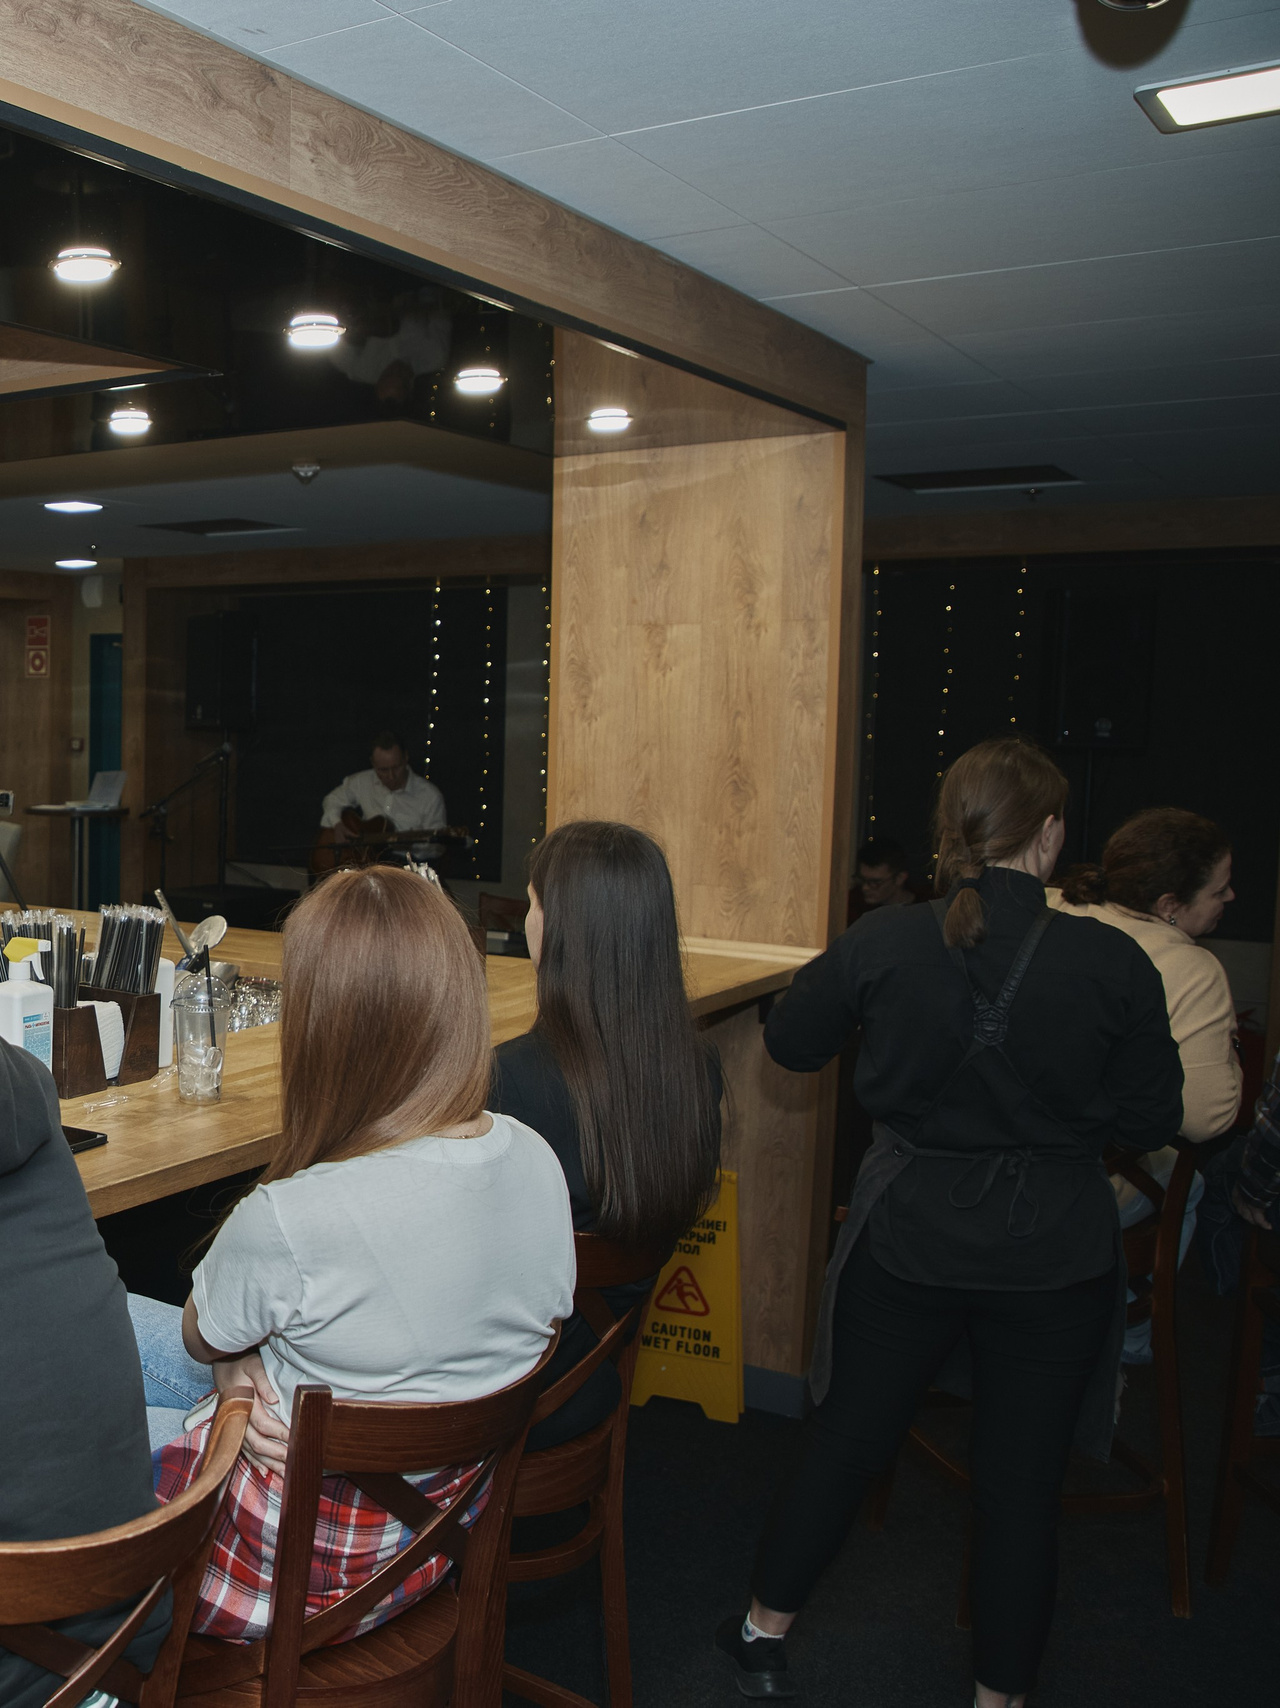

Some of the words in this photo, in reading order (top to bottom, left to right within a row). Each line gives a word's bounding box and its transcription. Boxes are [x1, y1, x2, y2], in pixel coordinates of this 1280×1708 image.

[651, 1321, 712, 1343] CAUTION
[641, 1334, 670, 1350] WET
[676, 1340, 720, 1359] FLOOR
